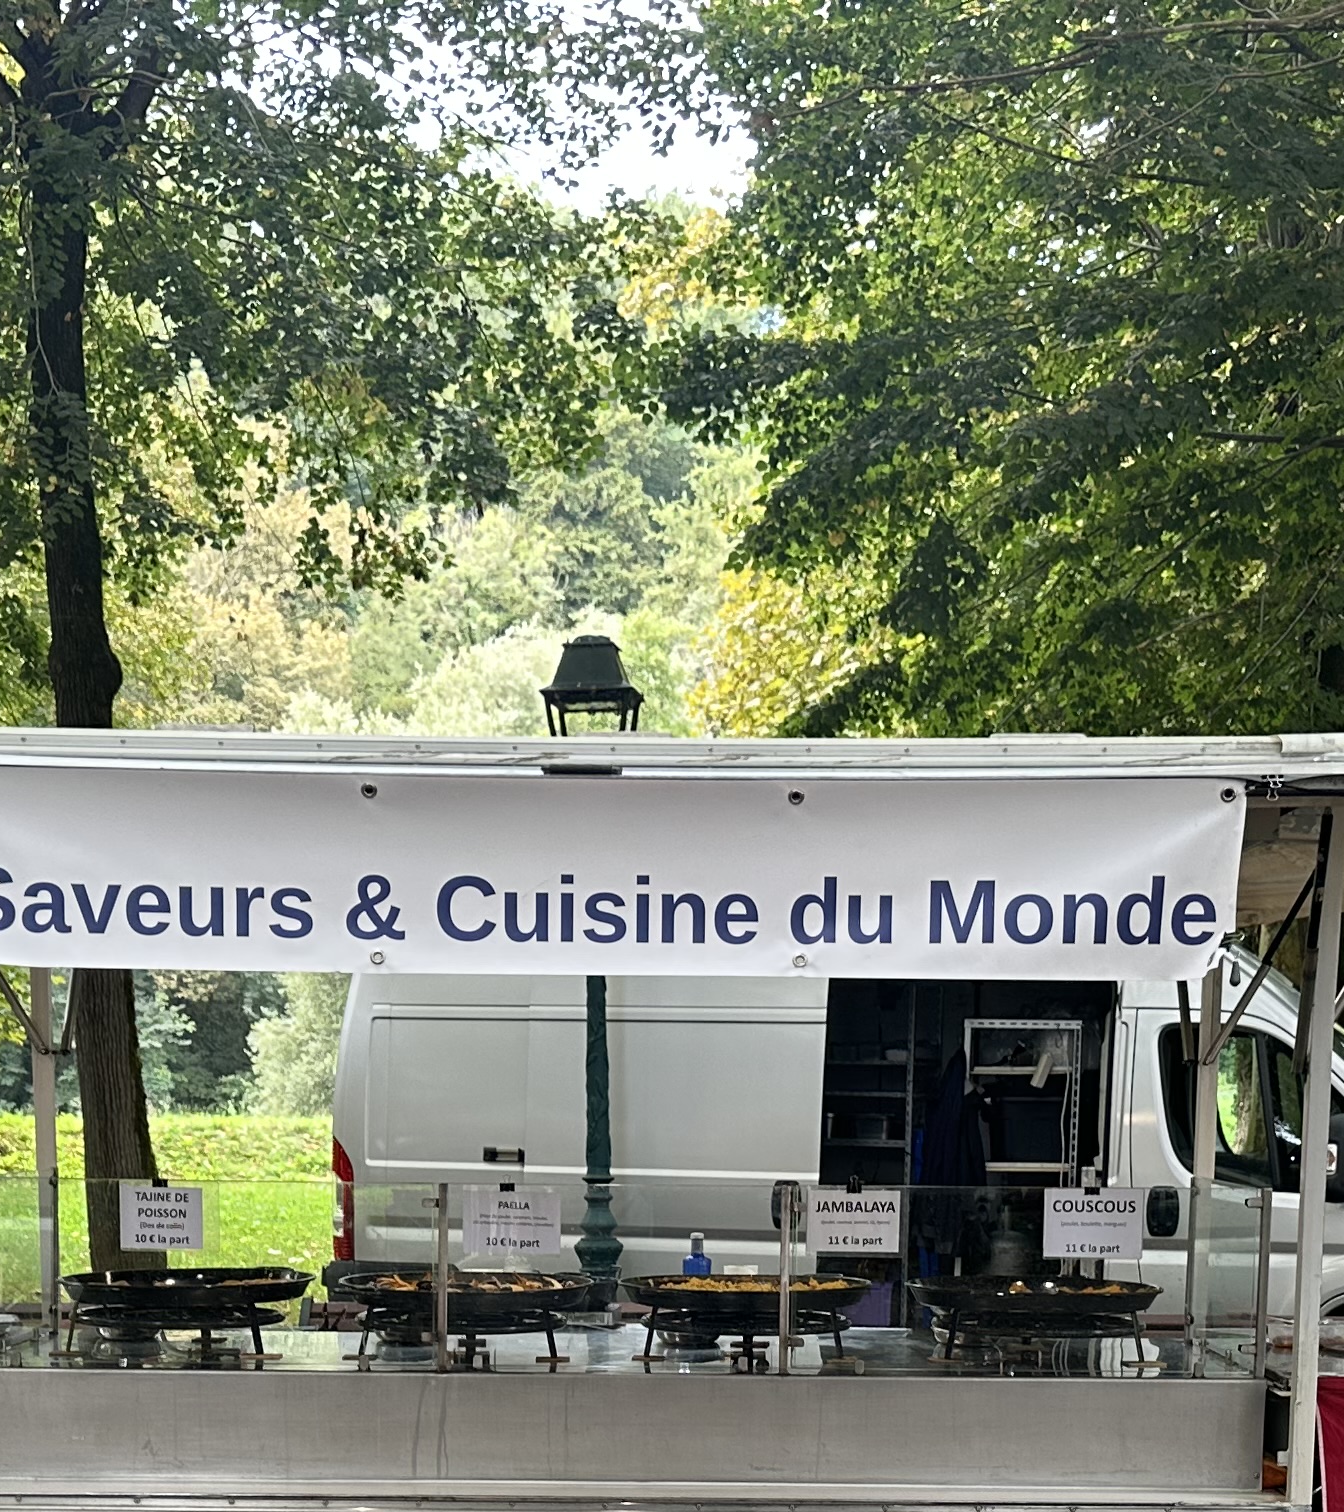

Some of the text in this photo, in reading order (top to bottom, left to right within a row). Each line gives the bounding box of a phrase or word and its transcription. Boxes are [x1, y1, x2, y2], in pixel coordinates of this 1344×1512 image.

[346, 874, 406, 941] &
[436, 874, 759, 945] Cuisine
[790, 876, 893, 945] du
[929, 875, 1217, 946] Monde
[135, 1191, 190, 1203] TAJINE DE
[498, 1201, 530, 1210] PAELLA
[815, 1201, 896, 1213] JAMBALAYA
[1052, 1200, 1136, 1213] COUSCOUS
[137, 1207, 187, 1219] POISSON
[135, 1233, 190, 1246] 10 € la part
[486, 1237, 540, 1249] 10 € la part
[828, 1235, 883, 1247] 11 € la part
[1065, 1243, 1121, 1255] 11 € la part
